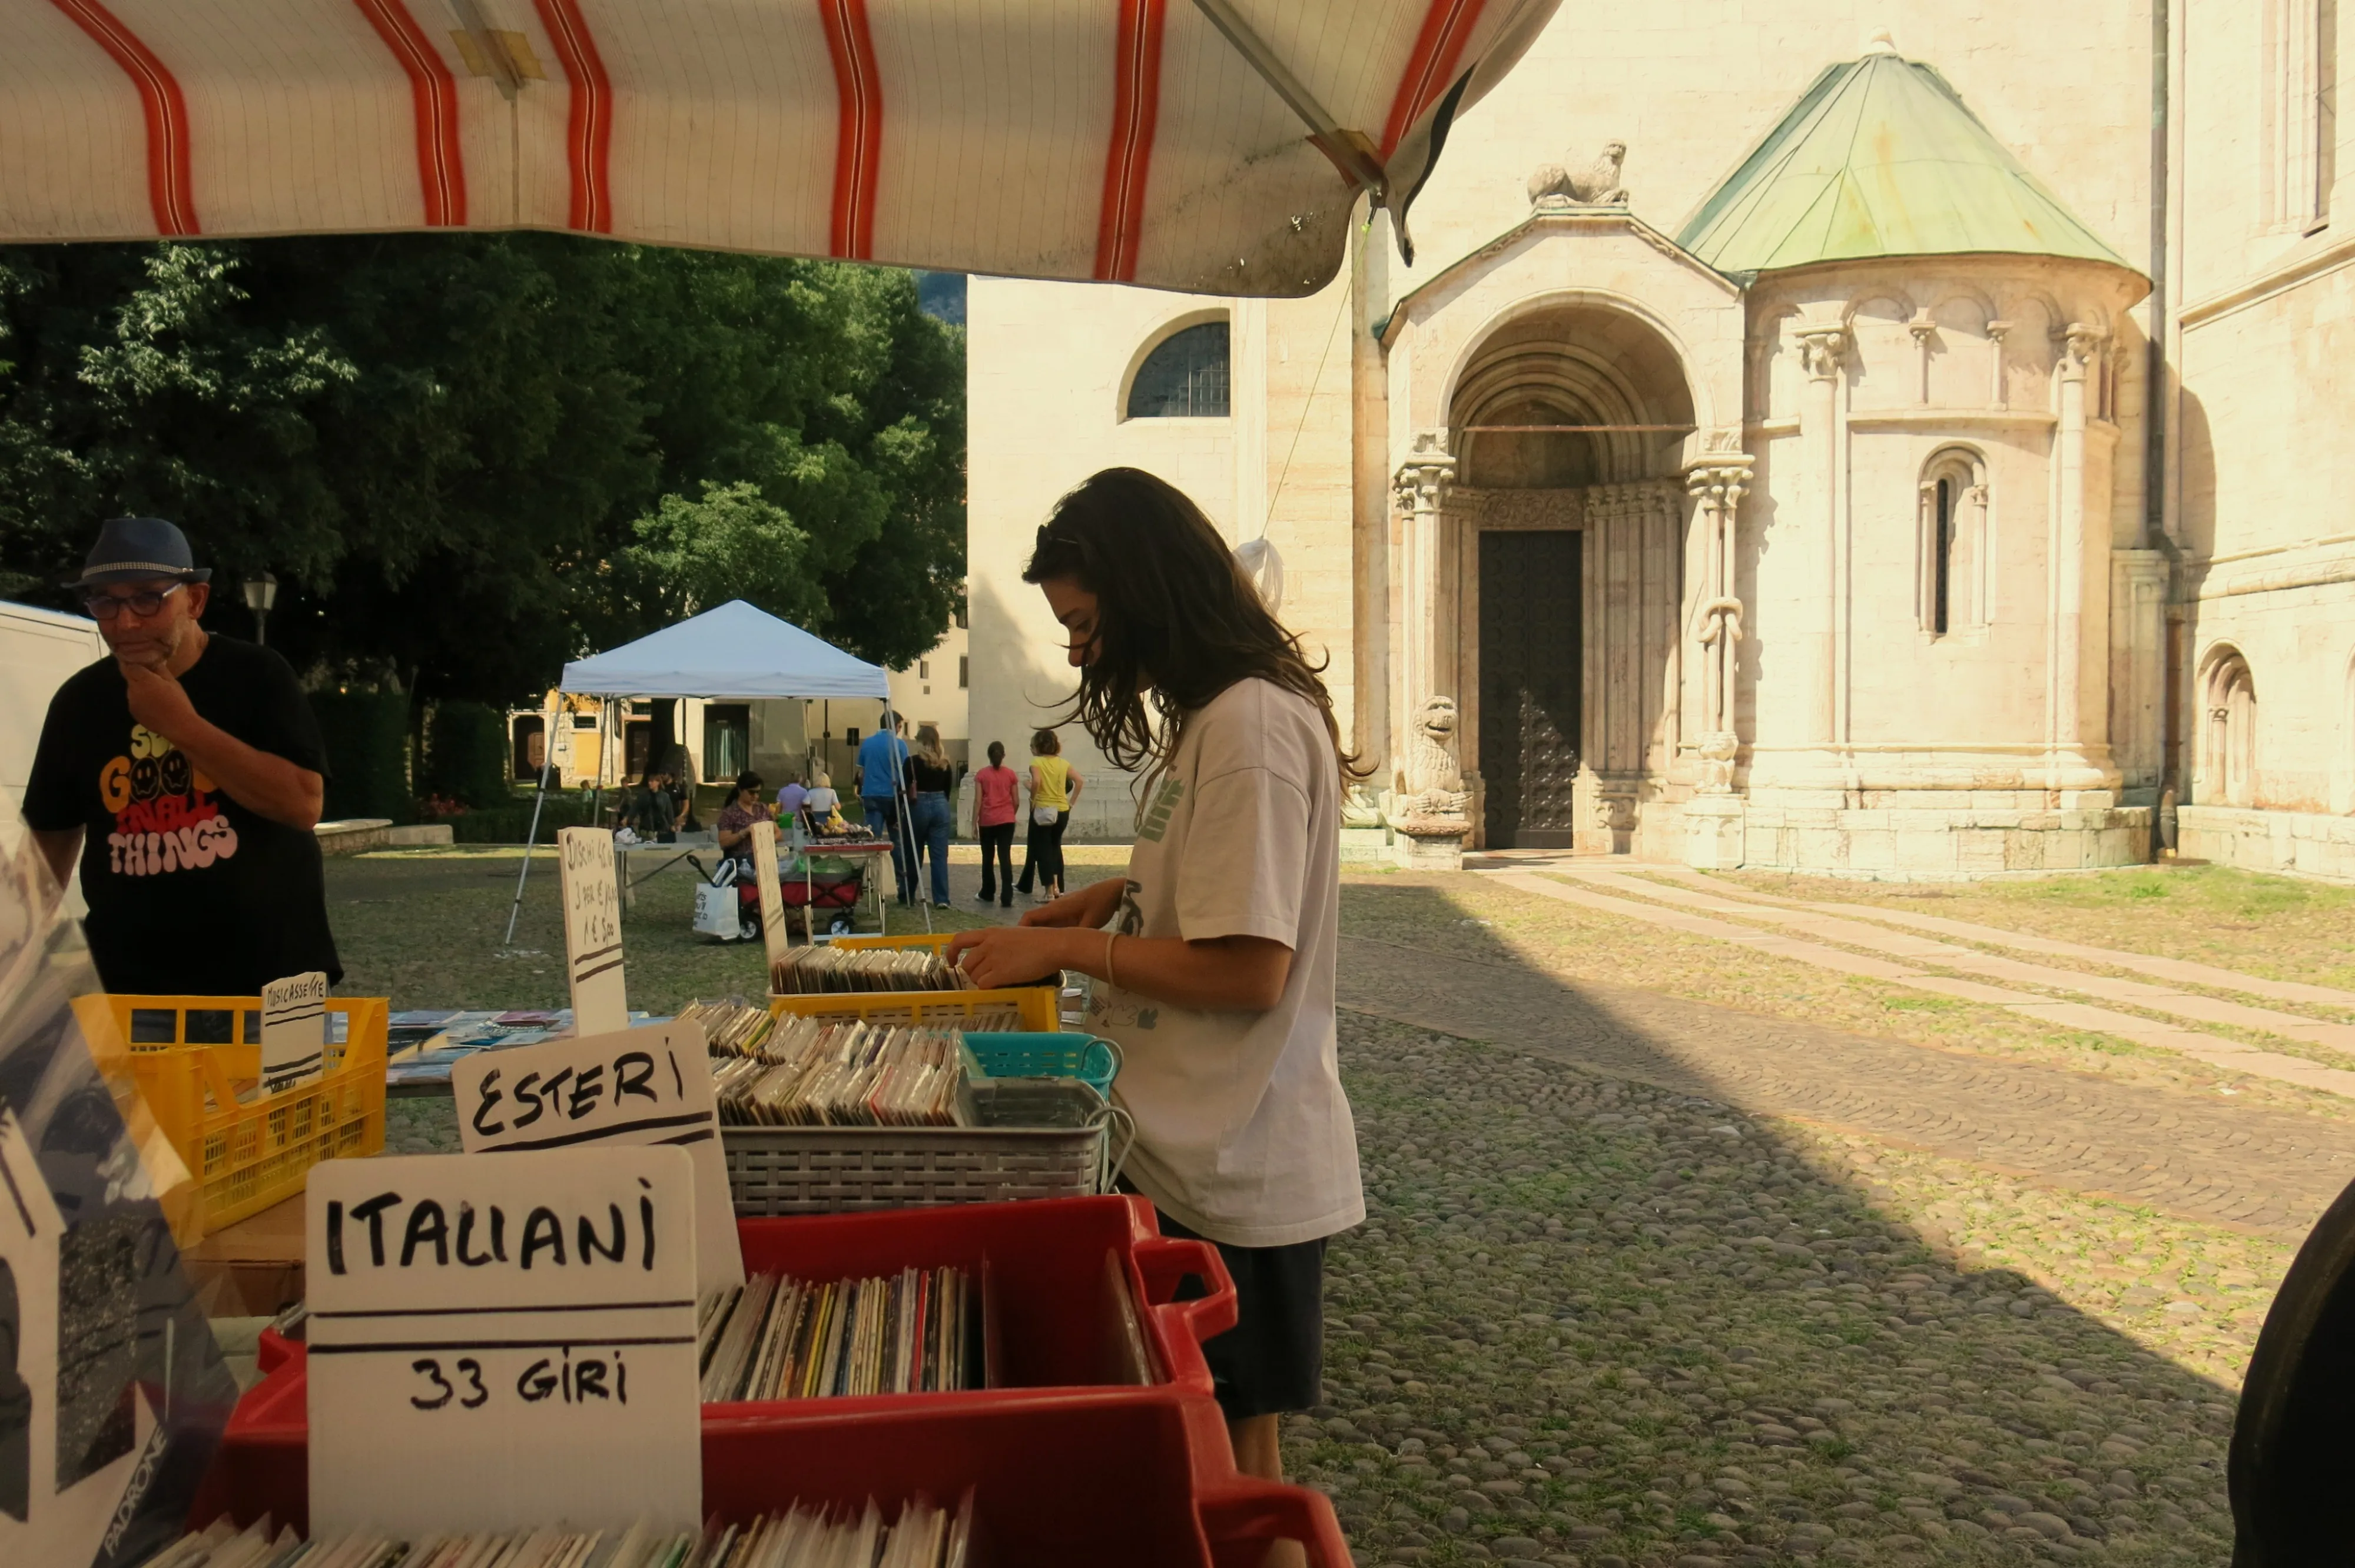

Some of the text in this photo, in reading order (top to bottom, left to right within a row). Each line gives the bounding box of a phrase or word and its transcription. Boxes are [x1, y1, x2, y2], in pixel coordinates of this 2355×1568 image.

[131, 723, 175, 759] SE
[108, 815, 238, 876] THINGS
[410, 1358, 489, 1410] 33
[104, 1423, 167, 1559] PADRONE
